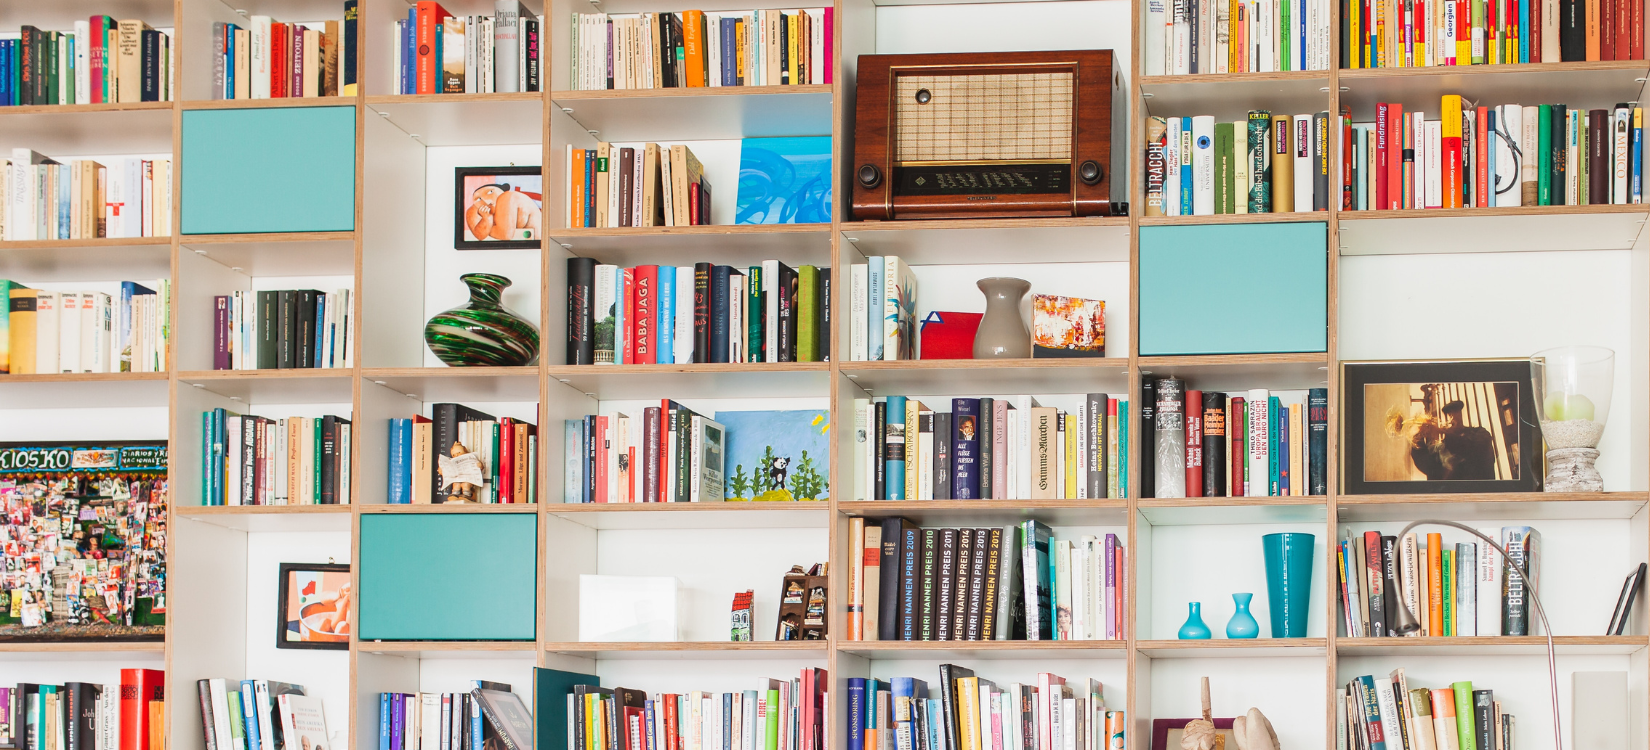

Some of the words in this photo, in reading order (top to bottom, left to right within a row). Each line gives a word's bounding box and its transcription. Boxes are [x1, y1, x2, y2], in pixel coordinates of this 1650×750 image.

[496, 18, 517, 28] Fallaci
[1378, 106, 1387, 149] Fundraising
[1616, 135, 1626, 179] MEXICO
[1148, 142, 1163, 207] BELTRACCHI
[638, 277, 648, 314] JAGA
[571, 284, 584, 342] Leidenschaften
[638, 318, 648, 354] BABA
[245, 419, 254, 446] ABGANG
[944, 531, 952, 548] 2011
[961, 530, 970, 548] 2014
[976, 530, 985, 549] 2013
[991, 530, 1000, 548] 2012
[924, 551, 932, 576] PREIS
[943, 550, 951, 575] PREIS
[960, 550, 968, 575] PREIS
[974, 550, 984, 575] PREIS
[988, 550, 998, 575] PREIS
[1371, 566, 1380, 594] PUTINS
[905, 578, 913, 614] NANNEN
[924, 578, 932, 614] NANNEN
[941, 578, 950, 614] NANNEN
[956, 577, 967, 613] NANNEN
[970, 577, 981, 614] NANNEN
[985, 577, 996, 613] NANNEN
[939, 616, 948, 641] HENRI
[955, 615, 964, 641] HENRI
[968, 616, 977, 641] HENRI
[982, 615, 992, 641] HENRI
[1362, 684, 1371, 705] Frauen
[758, 699, 767, 718] IRRE!
